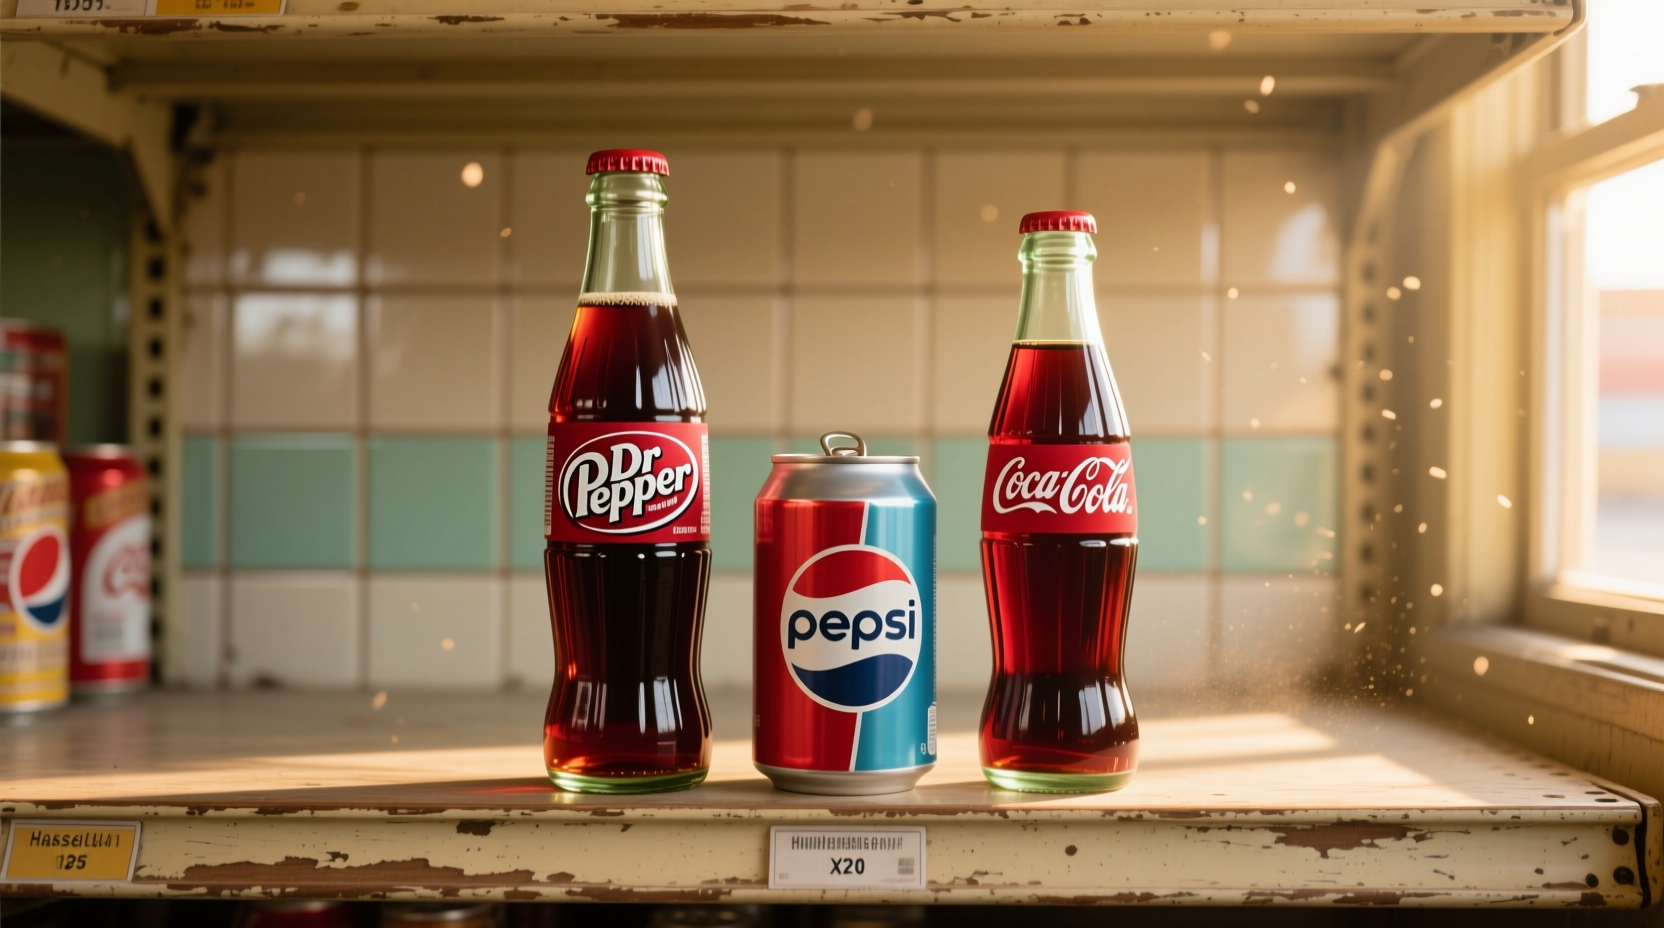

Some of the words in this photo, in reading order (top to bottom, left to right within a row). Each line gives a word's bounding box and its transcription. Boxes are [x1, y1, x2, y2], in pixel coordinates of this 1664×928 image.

[563, 452, 692, 523] Pepper
[610, 443, 661, 482] Dr
[993, 456, 1130, 514] Coca-Cola
[788, 599, 915, 650] pepsi
[830, 858, 865, 875] X20
